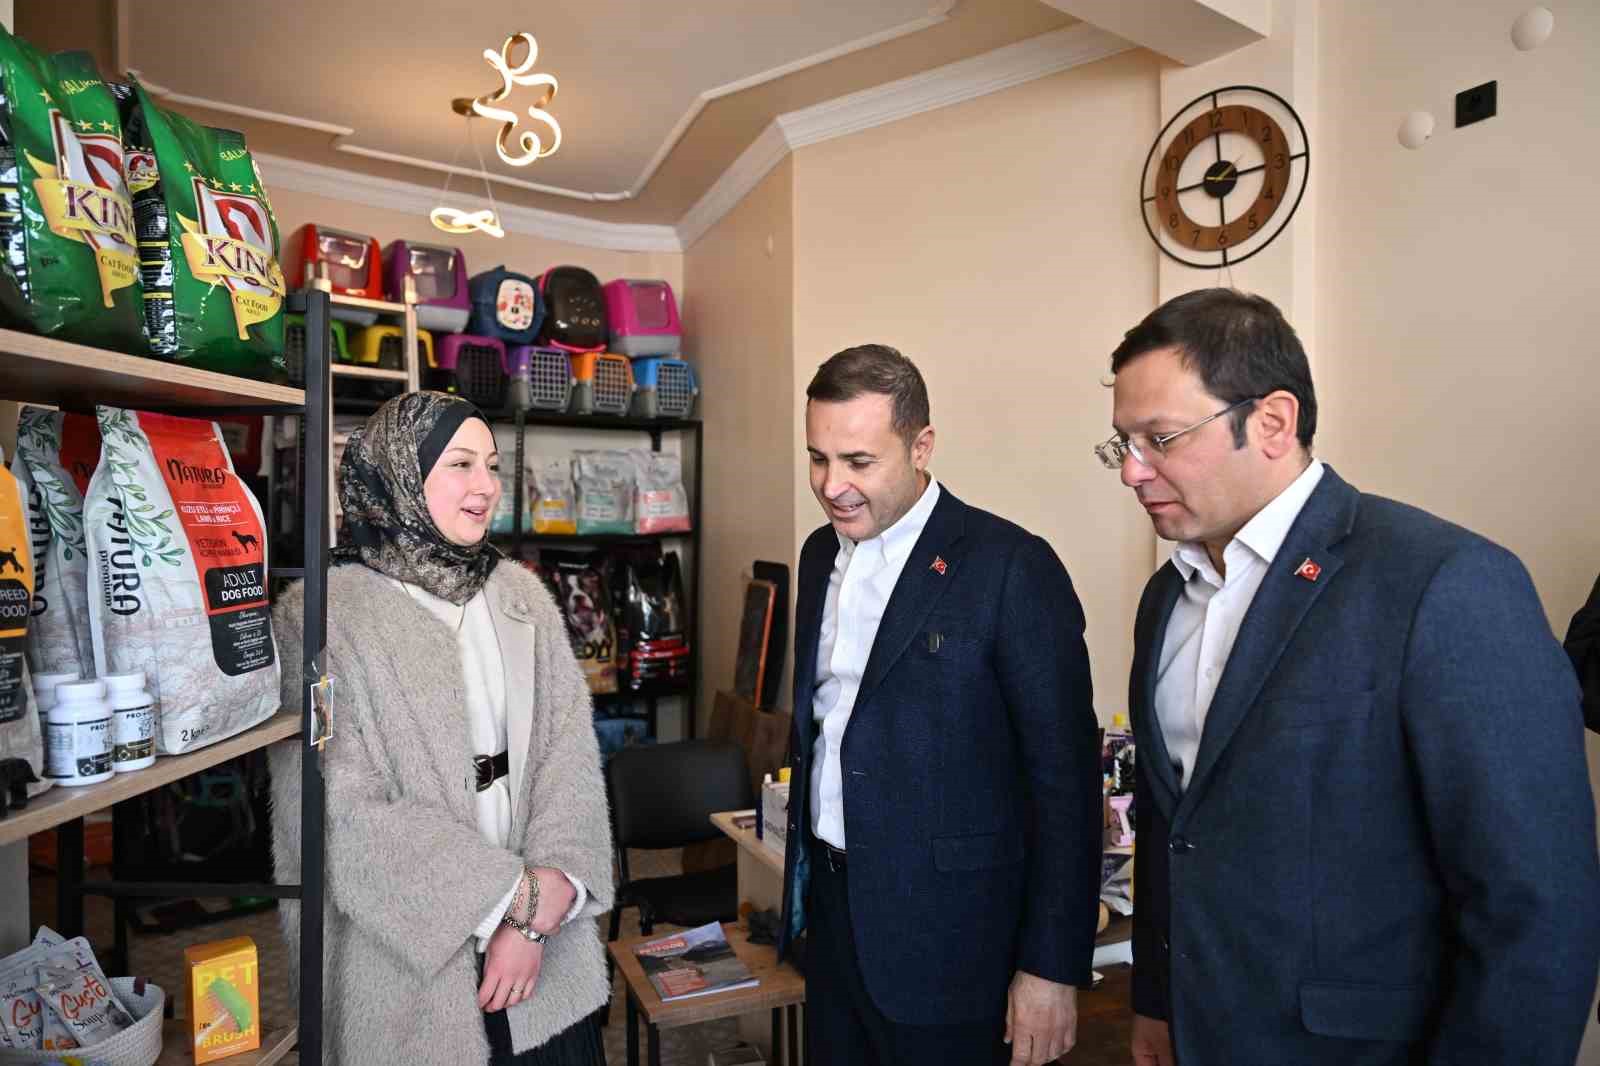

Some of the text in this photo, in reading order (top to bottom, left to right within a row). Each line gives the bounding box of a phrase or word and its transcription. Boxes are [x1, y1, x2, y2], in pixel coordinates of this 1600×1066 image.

[1208, 111, 1223, 128] 12
[1262, 126, 1273, 142] 2
[1273, 153, 1285, 170] 3
[1161, 187, 1171, 200] 9
[64, 184, 137, 234] KIN
[1168, 213, 1179, 229] 8
[1248, 214, 1258, 230] 5
[1191, 229, 1201, 246] 7
[1217, 230, 1228, 245] 6
[167, 458, 226, 485] NATURA
[105, 496, 141, 616] ATURA
[99, 550, 112, 607] premium
[223, 569, 257, 588] ADULT
[0, 589, 28, 601] REED
[221, 585, 264, 601] DOG FOOD
[181, 729, 189, 742] 2
